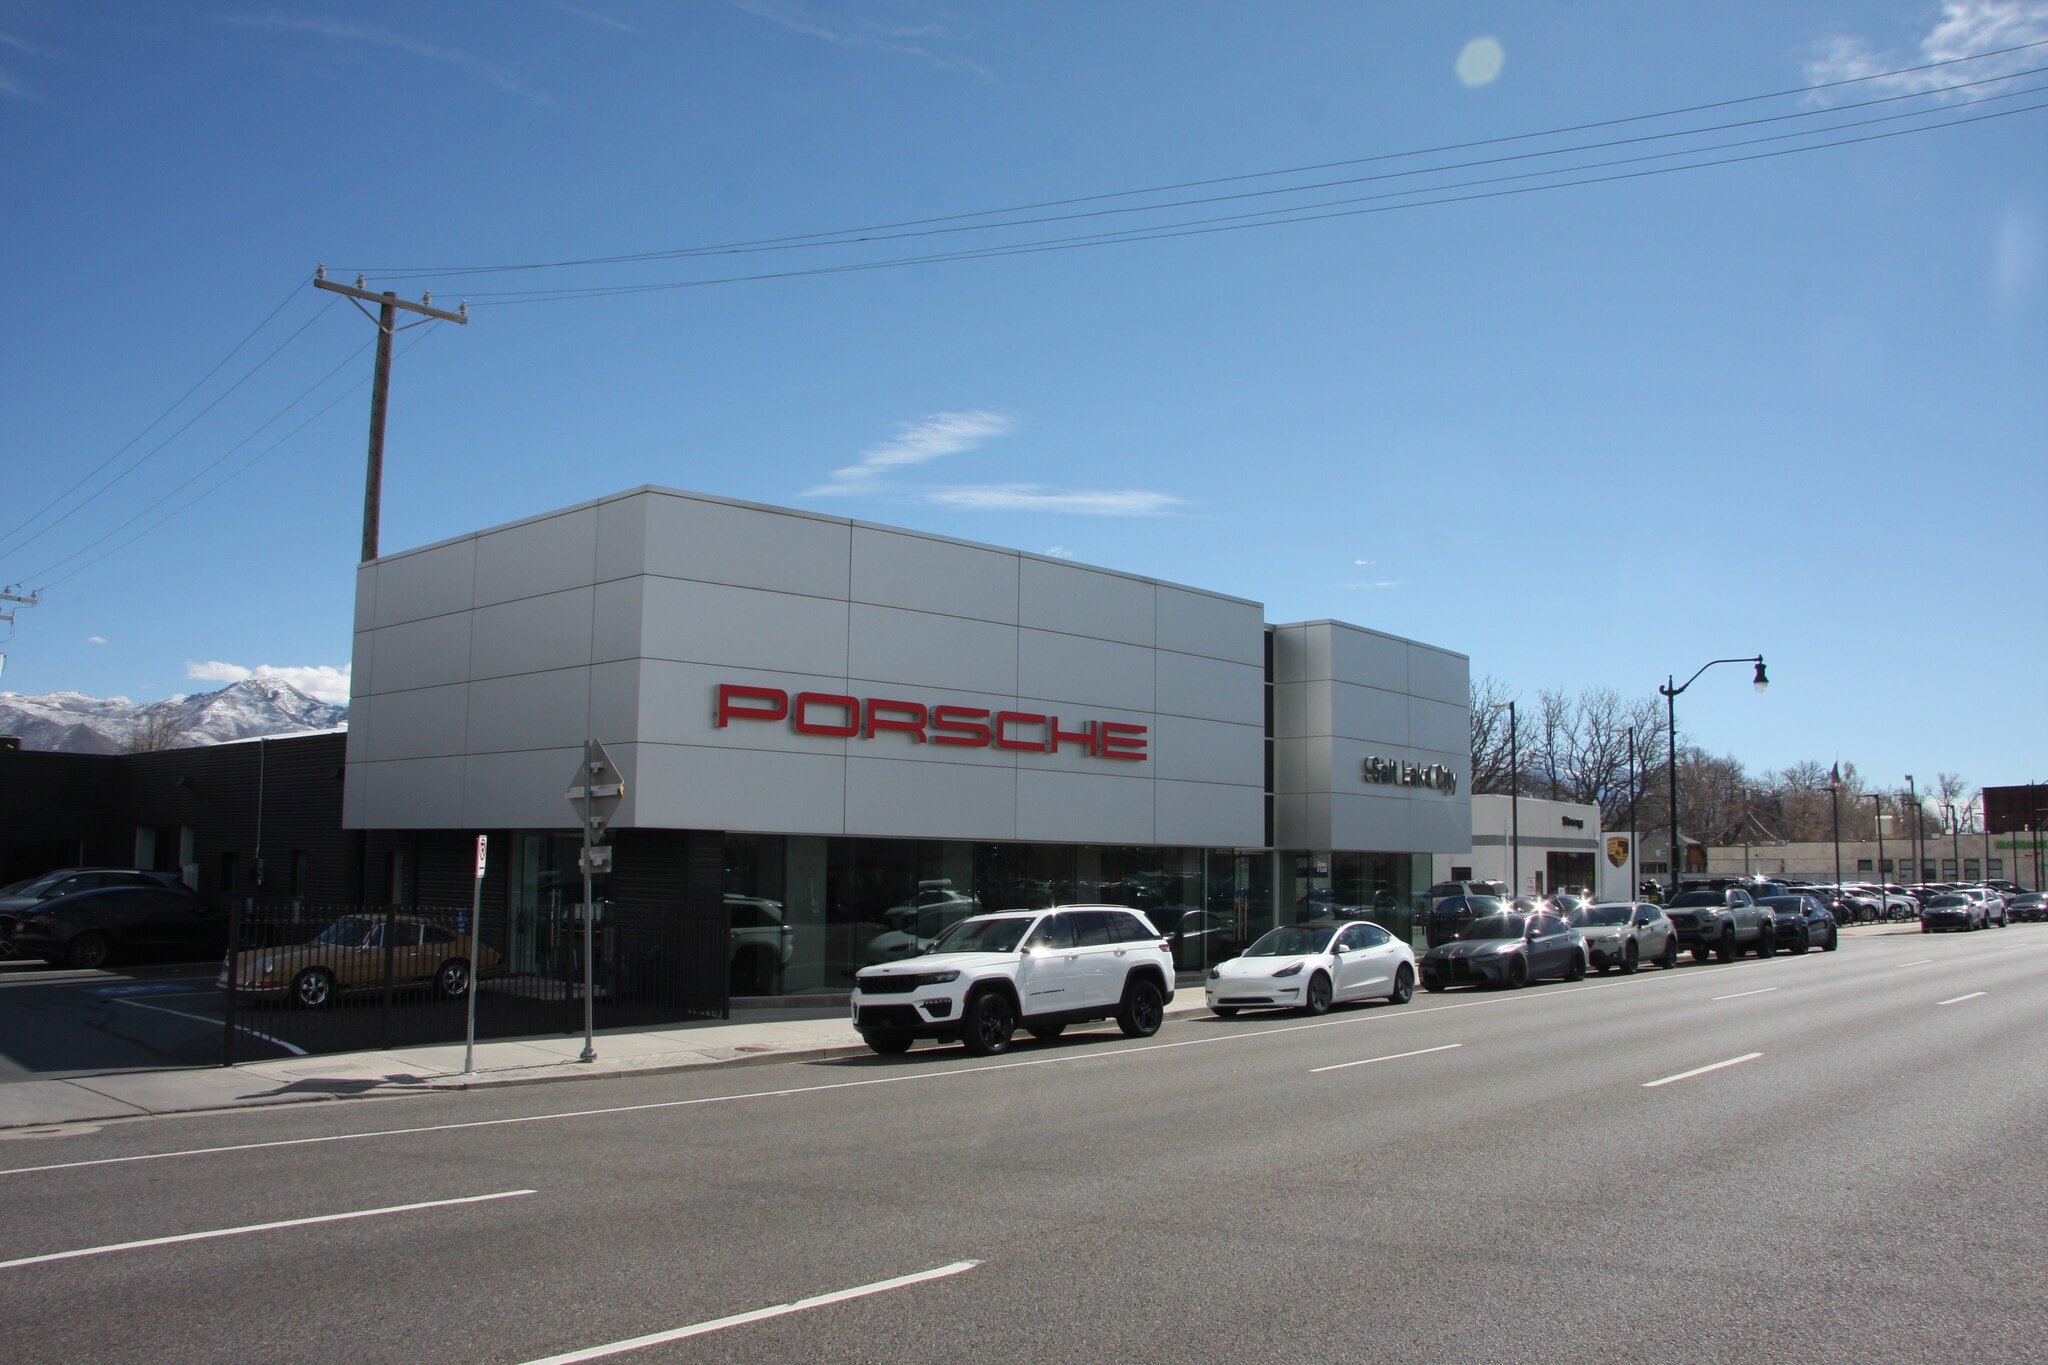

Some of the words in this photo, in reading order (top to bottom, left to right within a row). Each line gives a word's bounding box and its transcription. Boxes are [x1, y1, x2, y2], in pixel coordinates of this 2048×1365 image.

[715, 684, 1147, 760] PORSCHE
[1365, 756, 1397, 784] Salt
[1402, 760, 1431, 788] Lake
[1430, 764, 1457, 796] City
